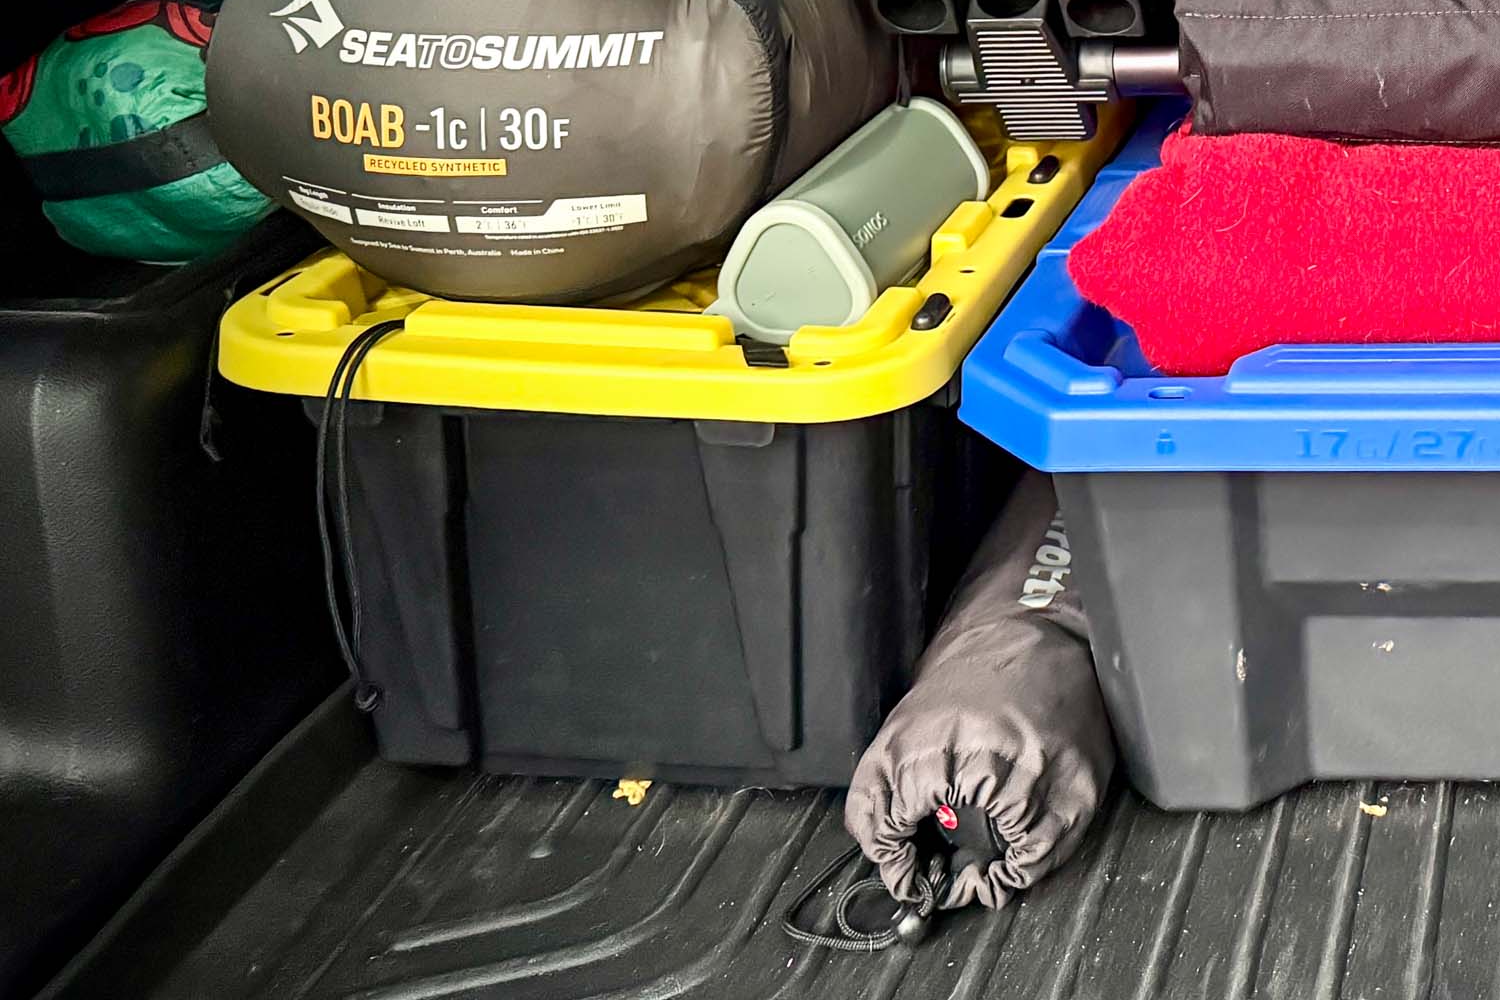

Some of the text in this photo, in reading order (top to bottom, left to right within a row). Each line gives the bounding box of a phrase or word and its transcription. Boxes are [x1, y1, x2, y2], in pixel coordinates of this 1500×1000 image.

[339, 29, 664, 71] SEATOSUMMIT
[311, 94, 405, 149] BOAB
[499, 107, 571, 151] 30F
[370, 158, 501, 173] RECYCLED SYNTHETIC
[481, 206, 517, 214] Comfort
